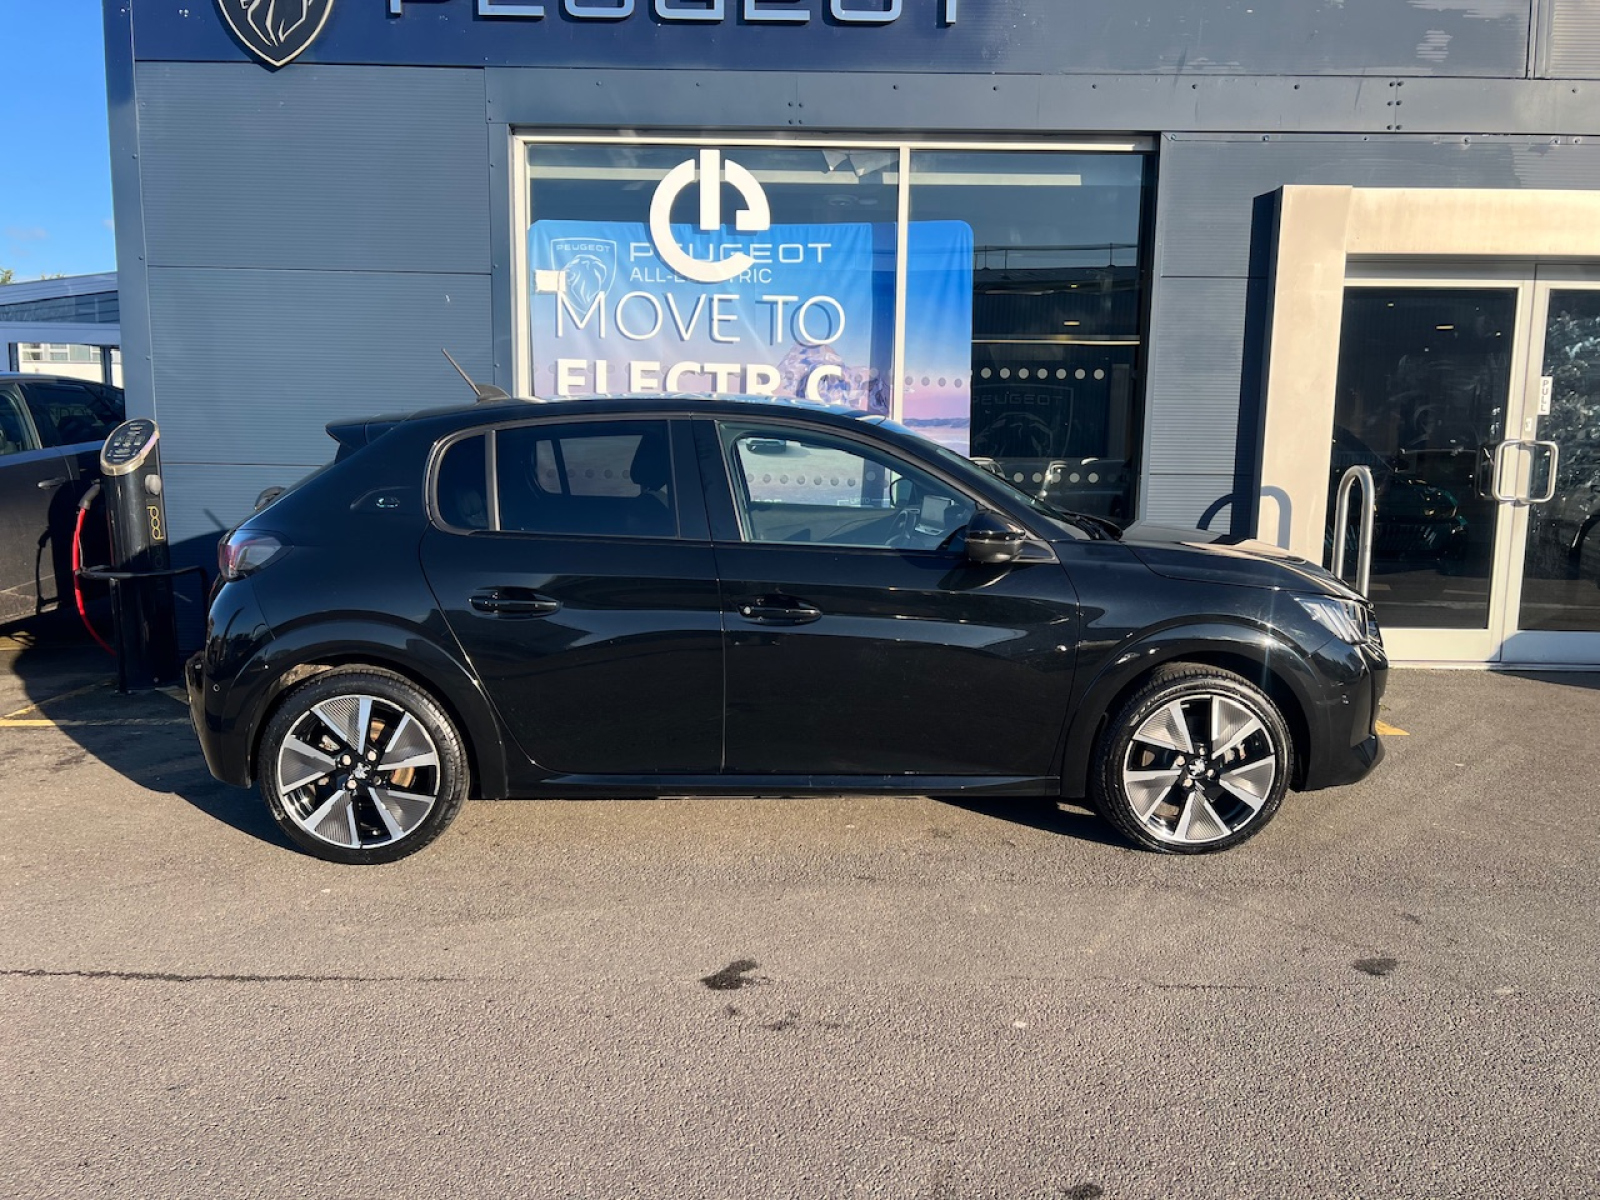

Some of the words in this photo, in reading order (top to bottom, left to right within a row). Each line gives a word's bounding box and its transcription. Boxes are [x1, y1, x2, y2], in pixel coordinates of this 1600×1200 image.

[556, 244, 611, 253] PEUGEOT
[629, 242, 832, 263] PUGEOT
[629, 266, 773, 284] ALL-RIC
[555, 290, 741, 341] MOVE
[762, 295, 846, 344] TO
[1540, 379, 1549, 412] PULL
[147, 505, 165, 540] pod
